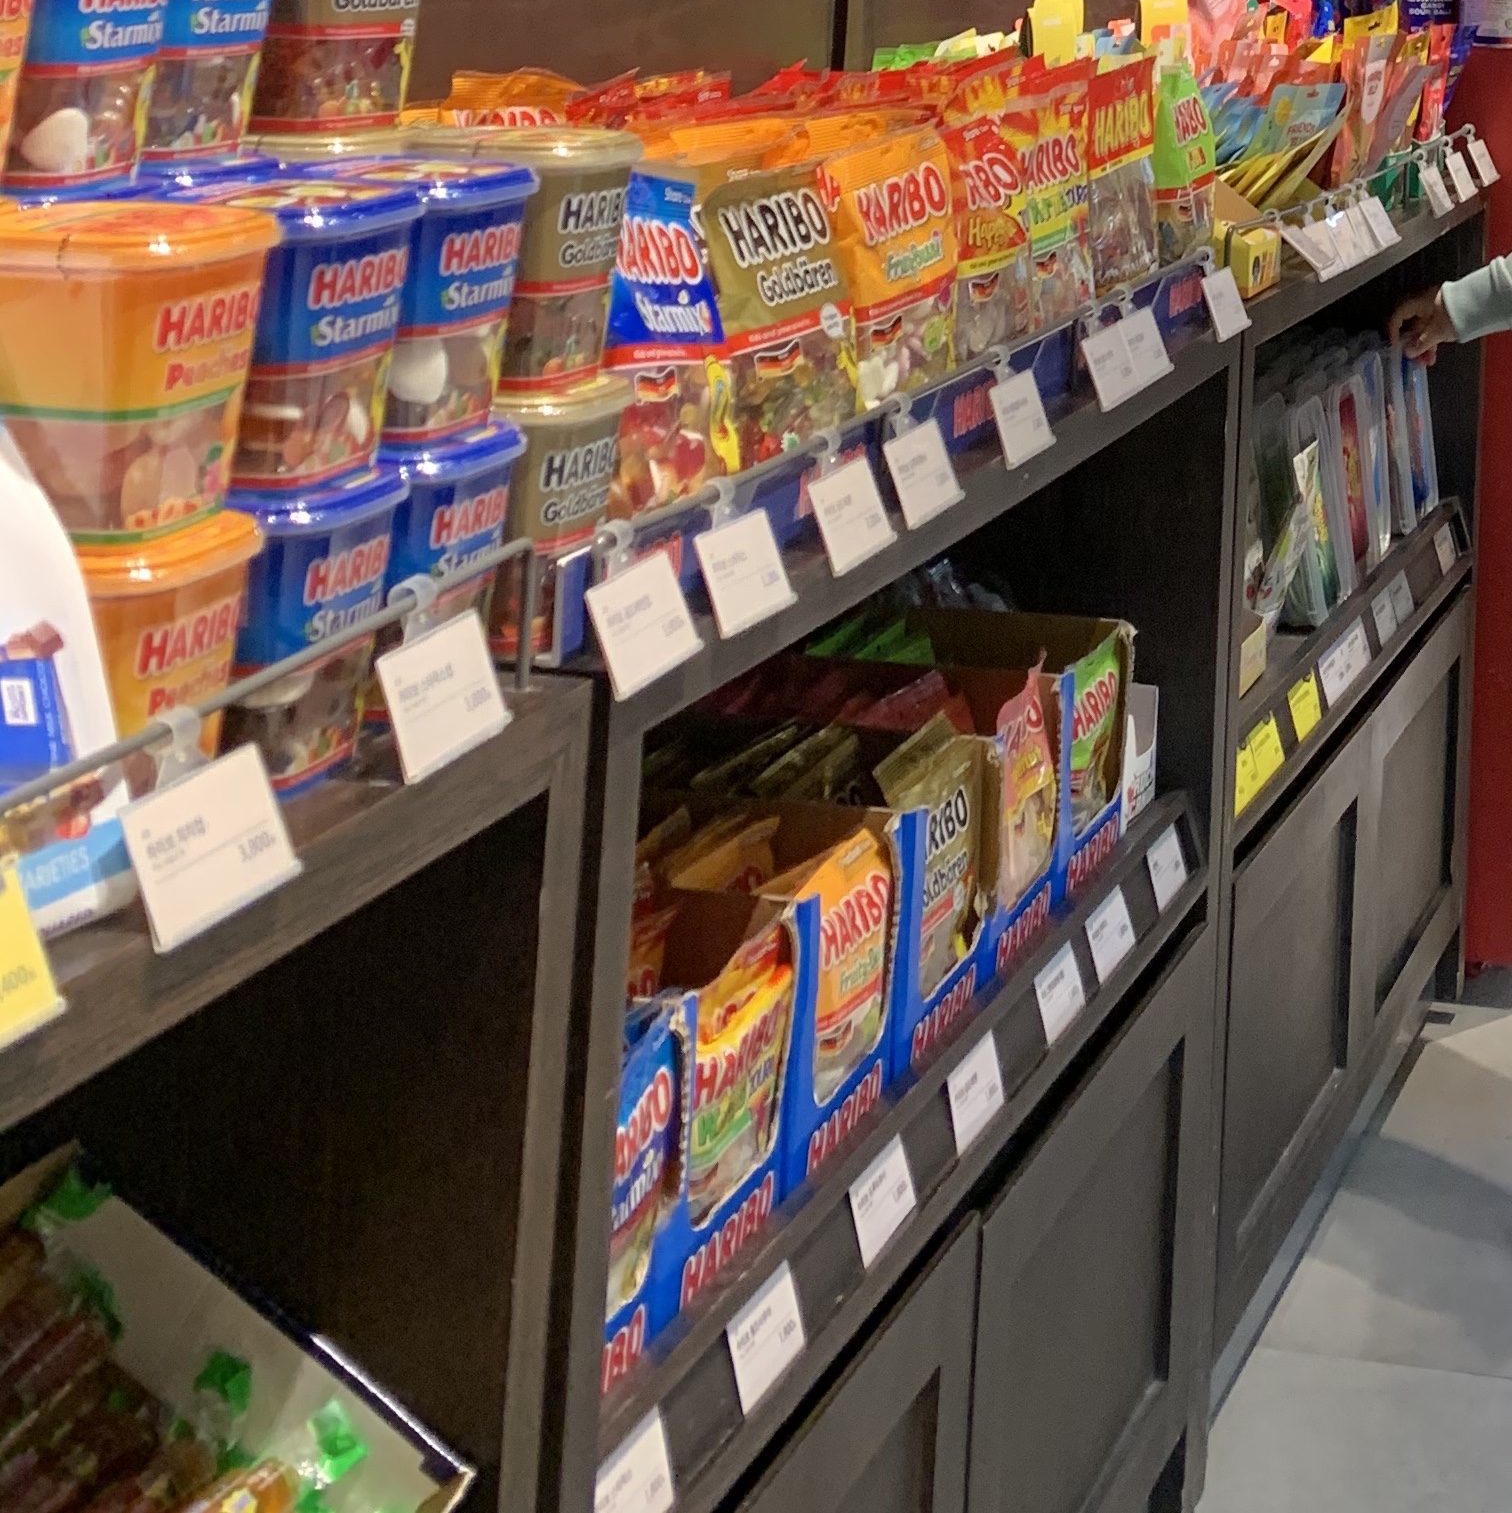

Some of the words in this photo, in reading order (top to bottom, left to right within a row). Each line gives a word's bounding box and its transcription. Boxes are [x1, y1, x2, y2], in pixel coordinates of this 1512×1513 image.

[1096, 90, 1152, 159] HARIBO
[719, 187, 831, 269] HARIBO
[855, 161, 948, 246] HARIBO
[757, 256, 838, 307] Goldbären
[429, 486, 510, 550] HARIB
[304, 534, 391, 607] HARIB
[310, 577, 382, 641] Starmi
[926, 785, 971, 864] RIBO
[1067, 811, 1120, 894] HARIBO
[22, 846, 90, 890] ARIETIES
[923, 849, 969, 908] oldbären
[820, 872, 890, 969] HARIBO
[997, 880, 1051, 975] HARIBO
[911, 963, 977, 1065] HARIBO
[807, 1058, 883, 1177] HARIBO
[680, 1171, 775, 1311] HARIBO
[600, 1303, 646, 1392] IBO
